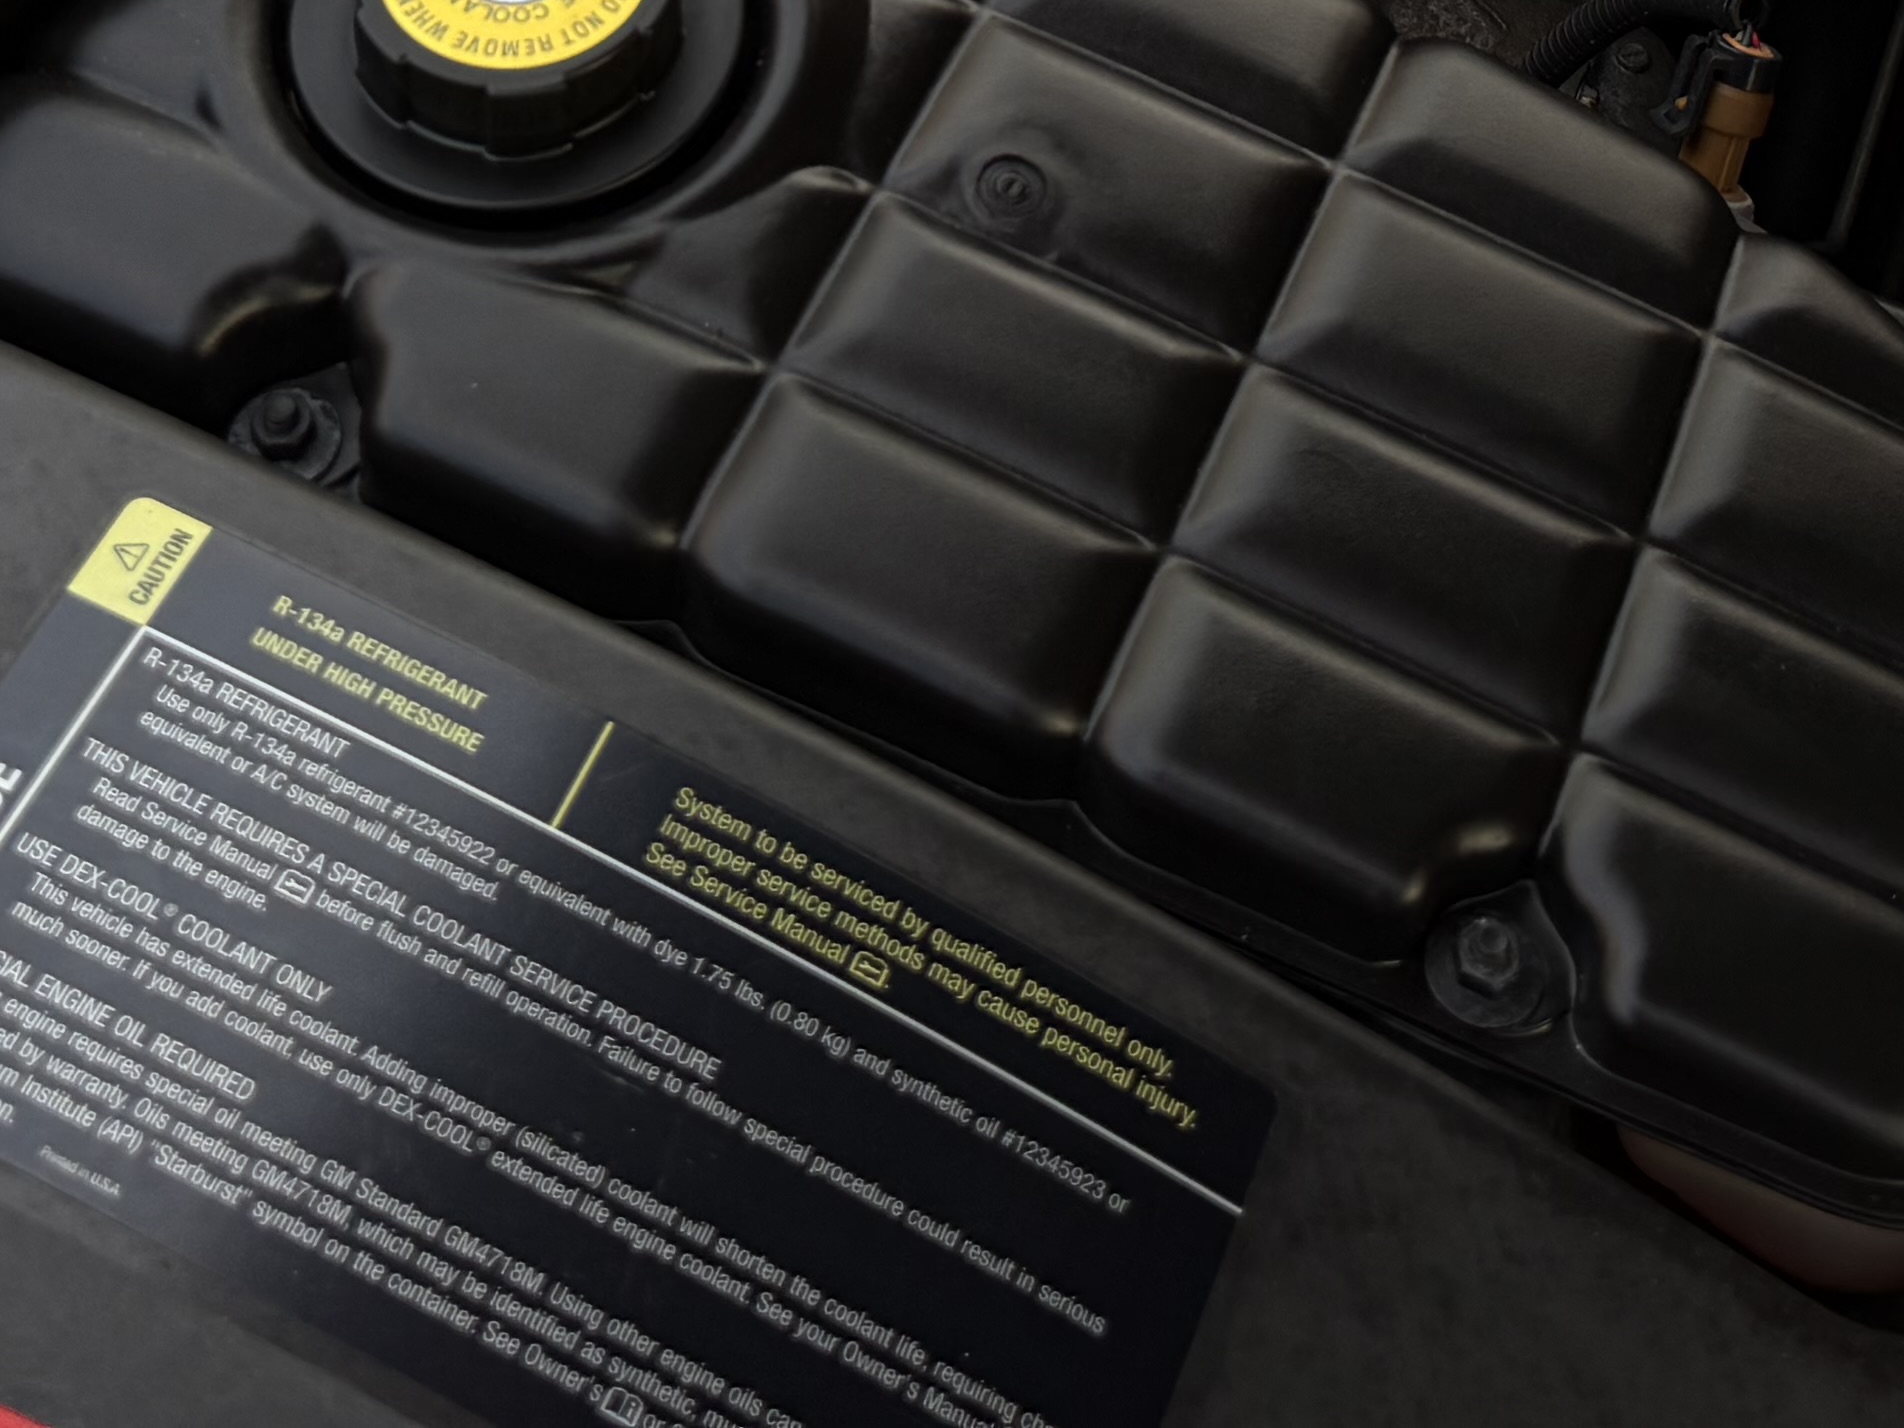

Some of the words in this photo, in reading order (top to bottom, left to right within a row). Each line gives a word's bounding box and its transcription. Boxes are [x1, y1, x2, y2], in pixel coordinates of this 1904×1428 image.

[451, 31, 554, 56] REMOVE
[562, 13, 605, 41] NOT
[127, 528, 194, 608] CAUTION
[142, 647, 213, 694] R-134a
[215, 682, 350, 757] REFRIGERANT
[250, 627, 322, 673] UNDER
[322, 662, 376, 698] HIGH
[375, 688, 484, 751] PRESSURE
[272, 595, 344, 642] R-134a
[346, 631, 487, 709] REFRIGERANT
[140, 712, 231, 763] equivalent
[229, 756, 252, 773] or
[249, 764, 287, 790] A/C
[285, 784, 350, 823] system
[352, 816, 386, 841] will
[386, 830, 410, 853] be
[412, 846, 498, 900] damaged.
[16, 832, 62, 866] USE
[177, 914, 276, 973] COOLANT
[275, 964, 331, 1001] ONLY
[82, 737, 129, 772] THIS
[129, 760, 212, 814] VEHICLE
[209, 802, 309, 872] REQUIRES
[301, 853, 324, 879] A
[327, 862, 405, 917] SPECIAL
[412, 905, 511, 965] COOLANT
[509, 955, 596, 1012] SERVICE
[595, 1000, 721, 1079] PROCEDURE
[155, 684, 189, 712] Use
[191, 706, 230, 734] only
[230, 721, 296, 766] R-134a
[297, 758, 391, 812] refrigerant
[391, 803, 495, 865] #12345922
[495, 858, 518, 875] or
[517, 870, 611, 925] equivalent
[611, 917, 651, 947] with
[653, 939, 687, 967] dye
[692, 957, 734, 990] 1.75
[734, 979, 764, 1009] lbs.
[770, 1000, 819, 1036] (0.80
[820, 1026, 850, 1057] kg)
[852, 1048, 890, 1076] and
[891, 1069, 972, 1122] synthetic
[975, 1116, 999, 1138] oil
[1001, 1129, 1105, 1199] #12345923
[1108, 1193, 1130, 1212] or
[646, 842, 686, 876] See
[690, 865, 767, 919] Service
[770, 907, 850, 963] Manual
[675, 787, 751, 840] System
[754, 829, 776, 853] to
[778, 841, 807, 869] be
[810, 863, 899, 919] serviced
[899, 907, 929, 939] by
[931, 928, 1021, 987] qualified
[1020, 979, 1125, 1046] personnel
[1127, 1039, 1172, 1078] only.
[659, 813, 755, 875] Improper
[756, 869, 831, 918] service
[834, 911, 924, 970] methods
[927, 962, 974, 999] may
[977, 990, 1039, 1034] cause
[1040, 1027, 1133, 1088] personal
[1135, 1075, 1195, 1128] injury.
[34, 974, 115, 1027] ENGINE
[113, 1015, 145, 1047] OIL
[149, 1033, 254, 1101] REQUIRED
